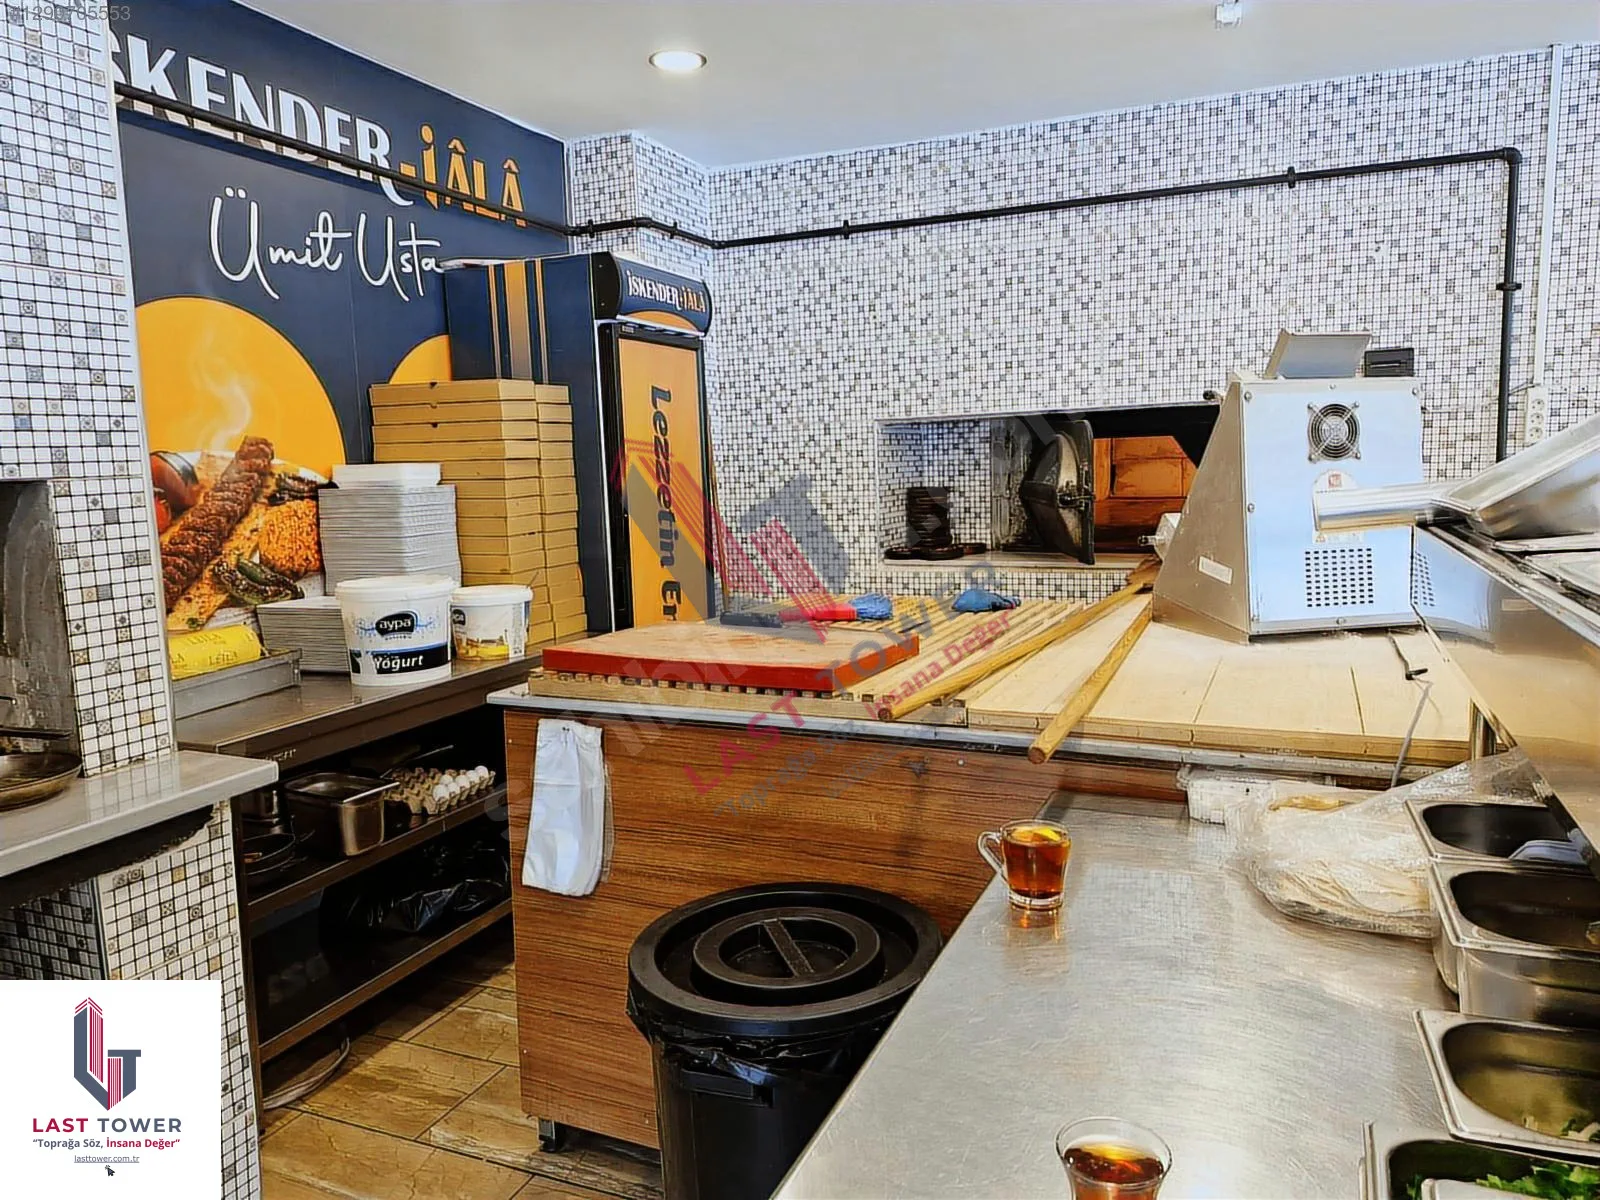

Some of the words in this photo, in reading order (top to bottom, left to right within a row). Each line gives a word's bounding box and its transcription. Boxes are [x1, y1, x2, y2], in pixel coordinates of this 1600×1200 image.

[209, 187, 352, 300] Ümit
[356, 212, 445, 302] Usta
[650, 383, 680, 569] Lezzetin
